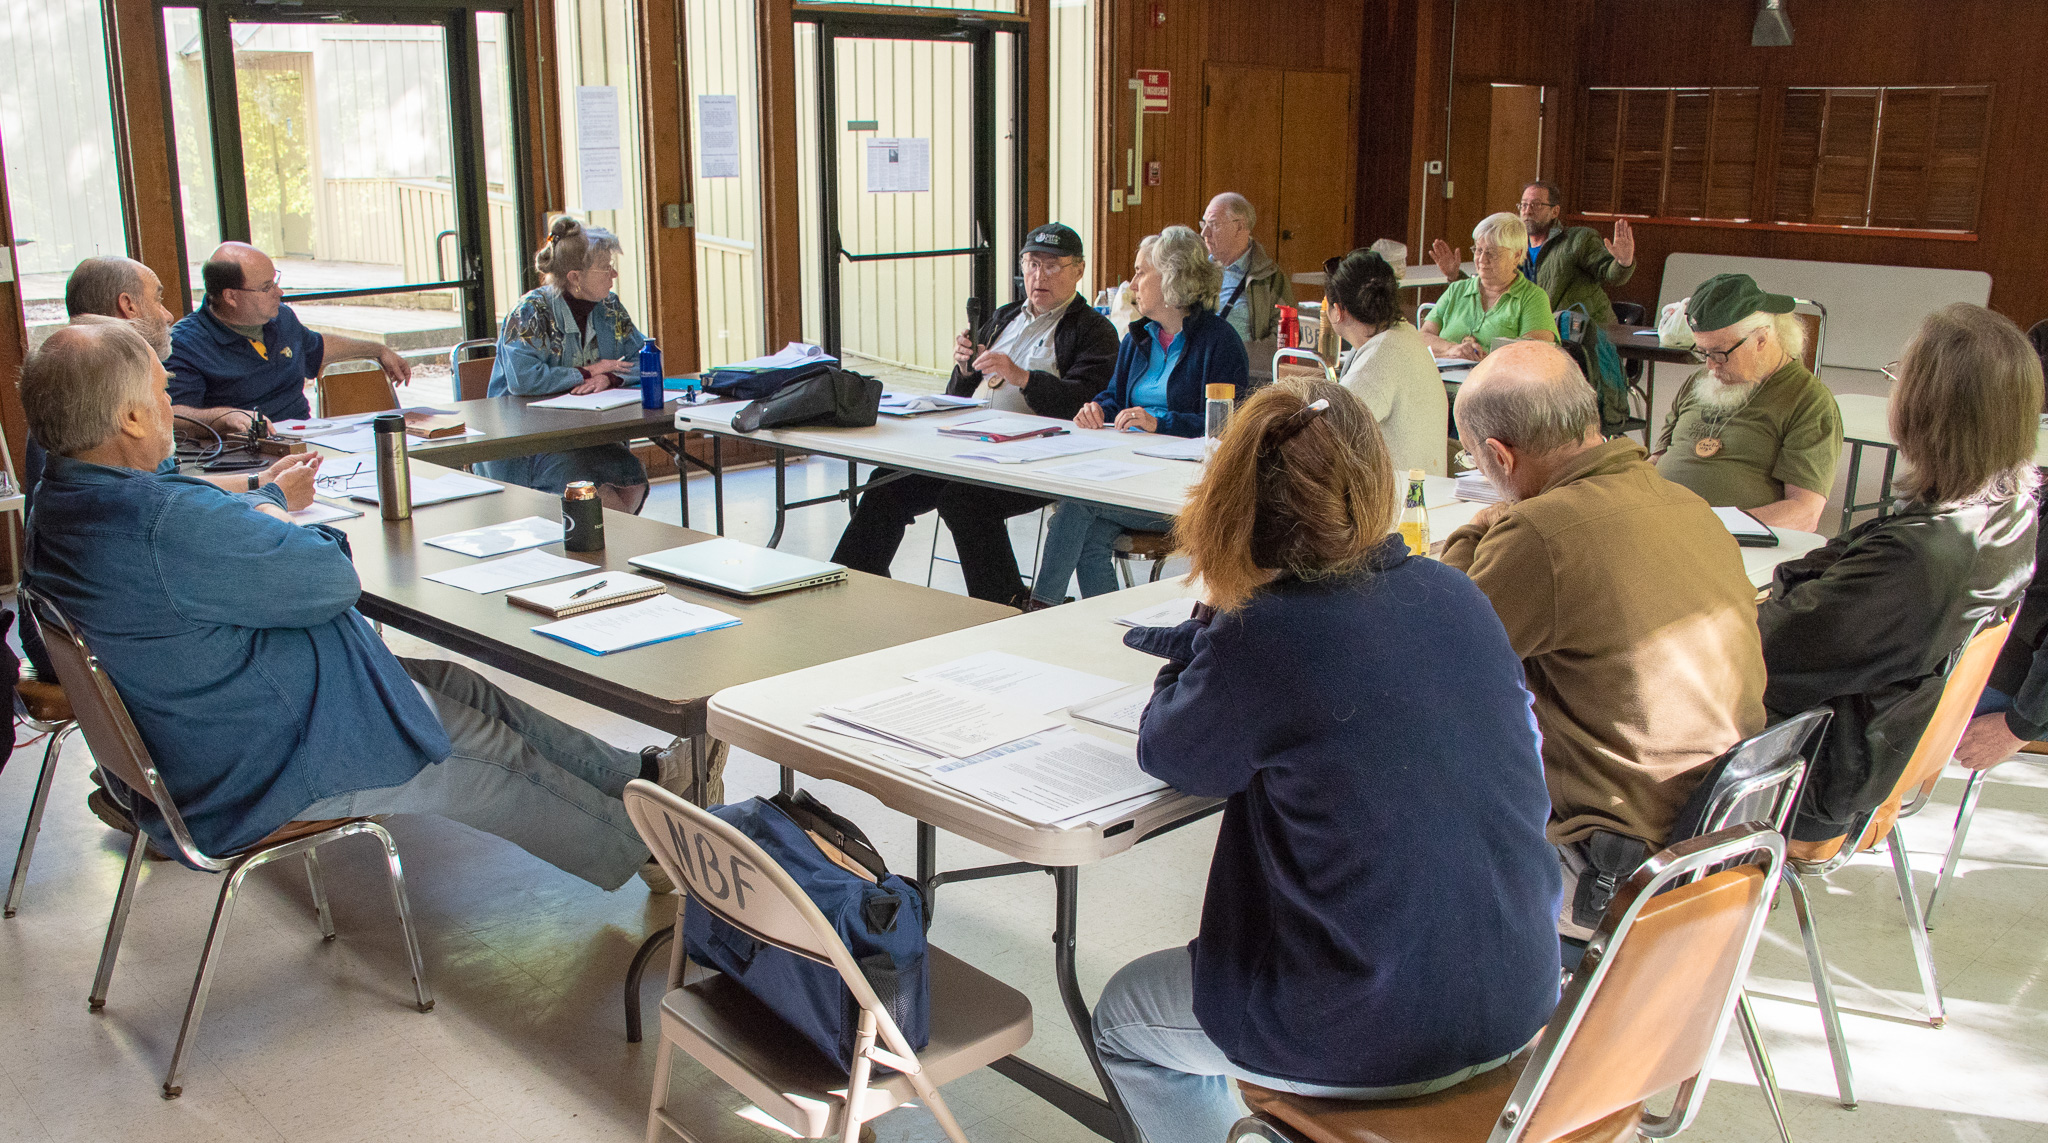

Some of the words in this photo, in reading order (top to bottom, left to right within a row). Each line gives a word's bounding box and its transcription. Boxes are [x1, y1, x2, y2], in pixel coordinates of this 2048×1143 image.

[1148, 74, 1159, 84] FIRE
[1143, 86, 1168, 96] TINGUISHER
[662, 810, 757, 910] NBF
